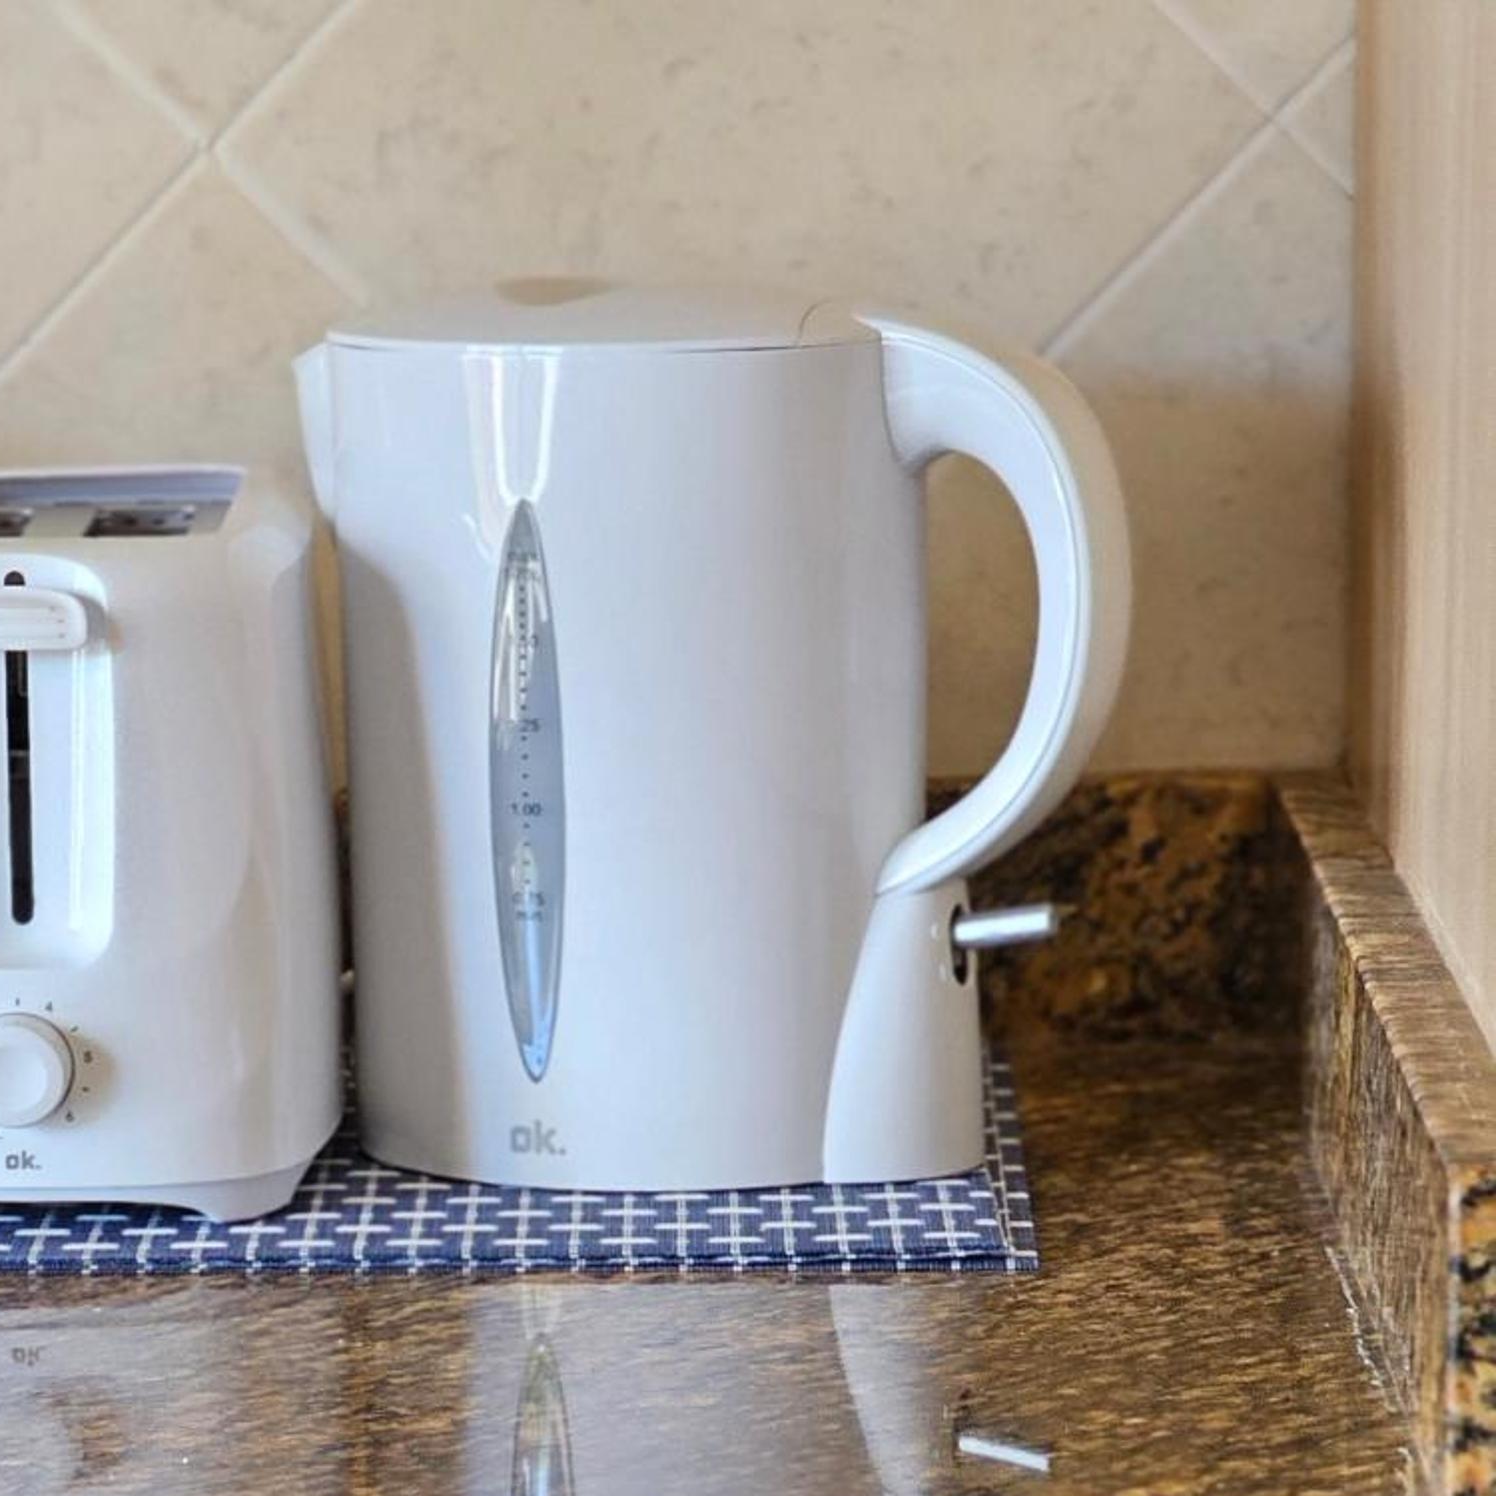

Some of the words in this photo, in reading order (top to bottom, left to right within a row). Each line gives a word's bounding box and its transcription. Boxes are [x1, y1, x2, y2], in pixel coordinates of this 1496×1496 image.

[45, 1001, 53, 1012] 4
[510, 1119, 567, 1156] ok.
[5, 1150, 43, 1170] ok.
